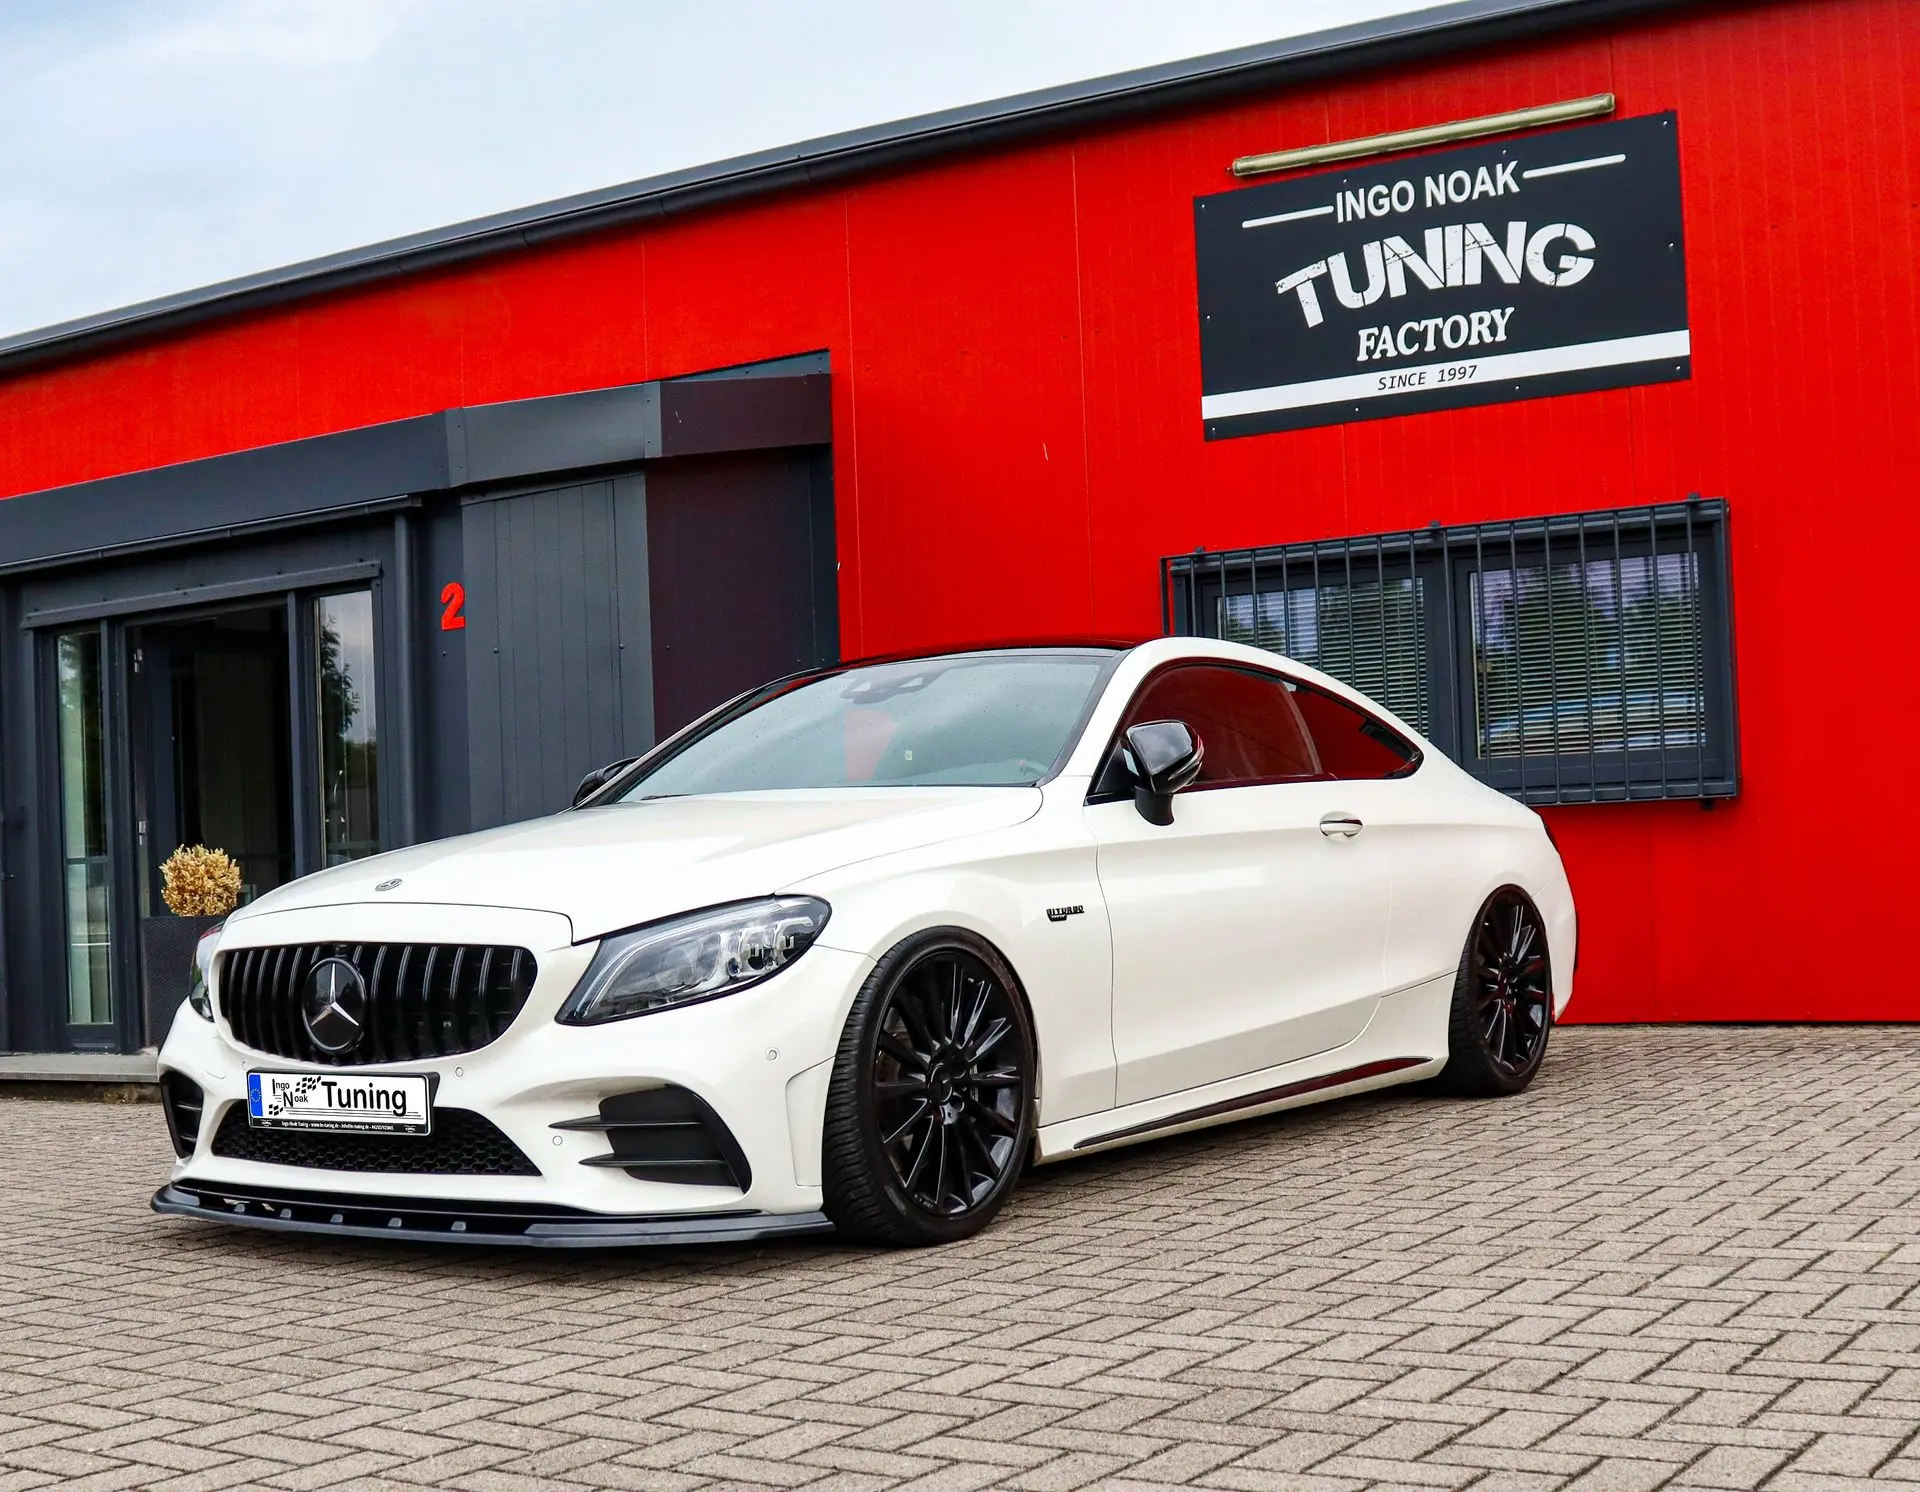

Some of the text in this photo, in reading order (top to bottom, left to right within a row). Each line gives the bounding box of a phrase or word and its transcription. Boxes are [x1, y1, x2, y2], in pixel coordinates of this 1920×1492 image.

[1336, 160, 1521, 224] INGO NOAK
[1275, 221, 1597, 328] TUNING
[1356, 306, 1515, 362] FACTORY
[1378, 364, 1478, 391] SINCE 1997
[440, 582, 466, 631] 2
[272, 1078, 290, 1095] Ingo
[283, 1091, 309, 1108] Noak
[321, 1081, 407, 1117] Tuning
